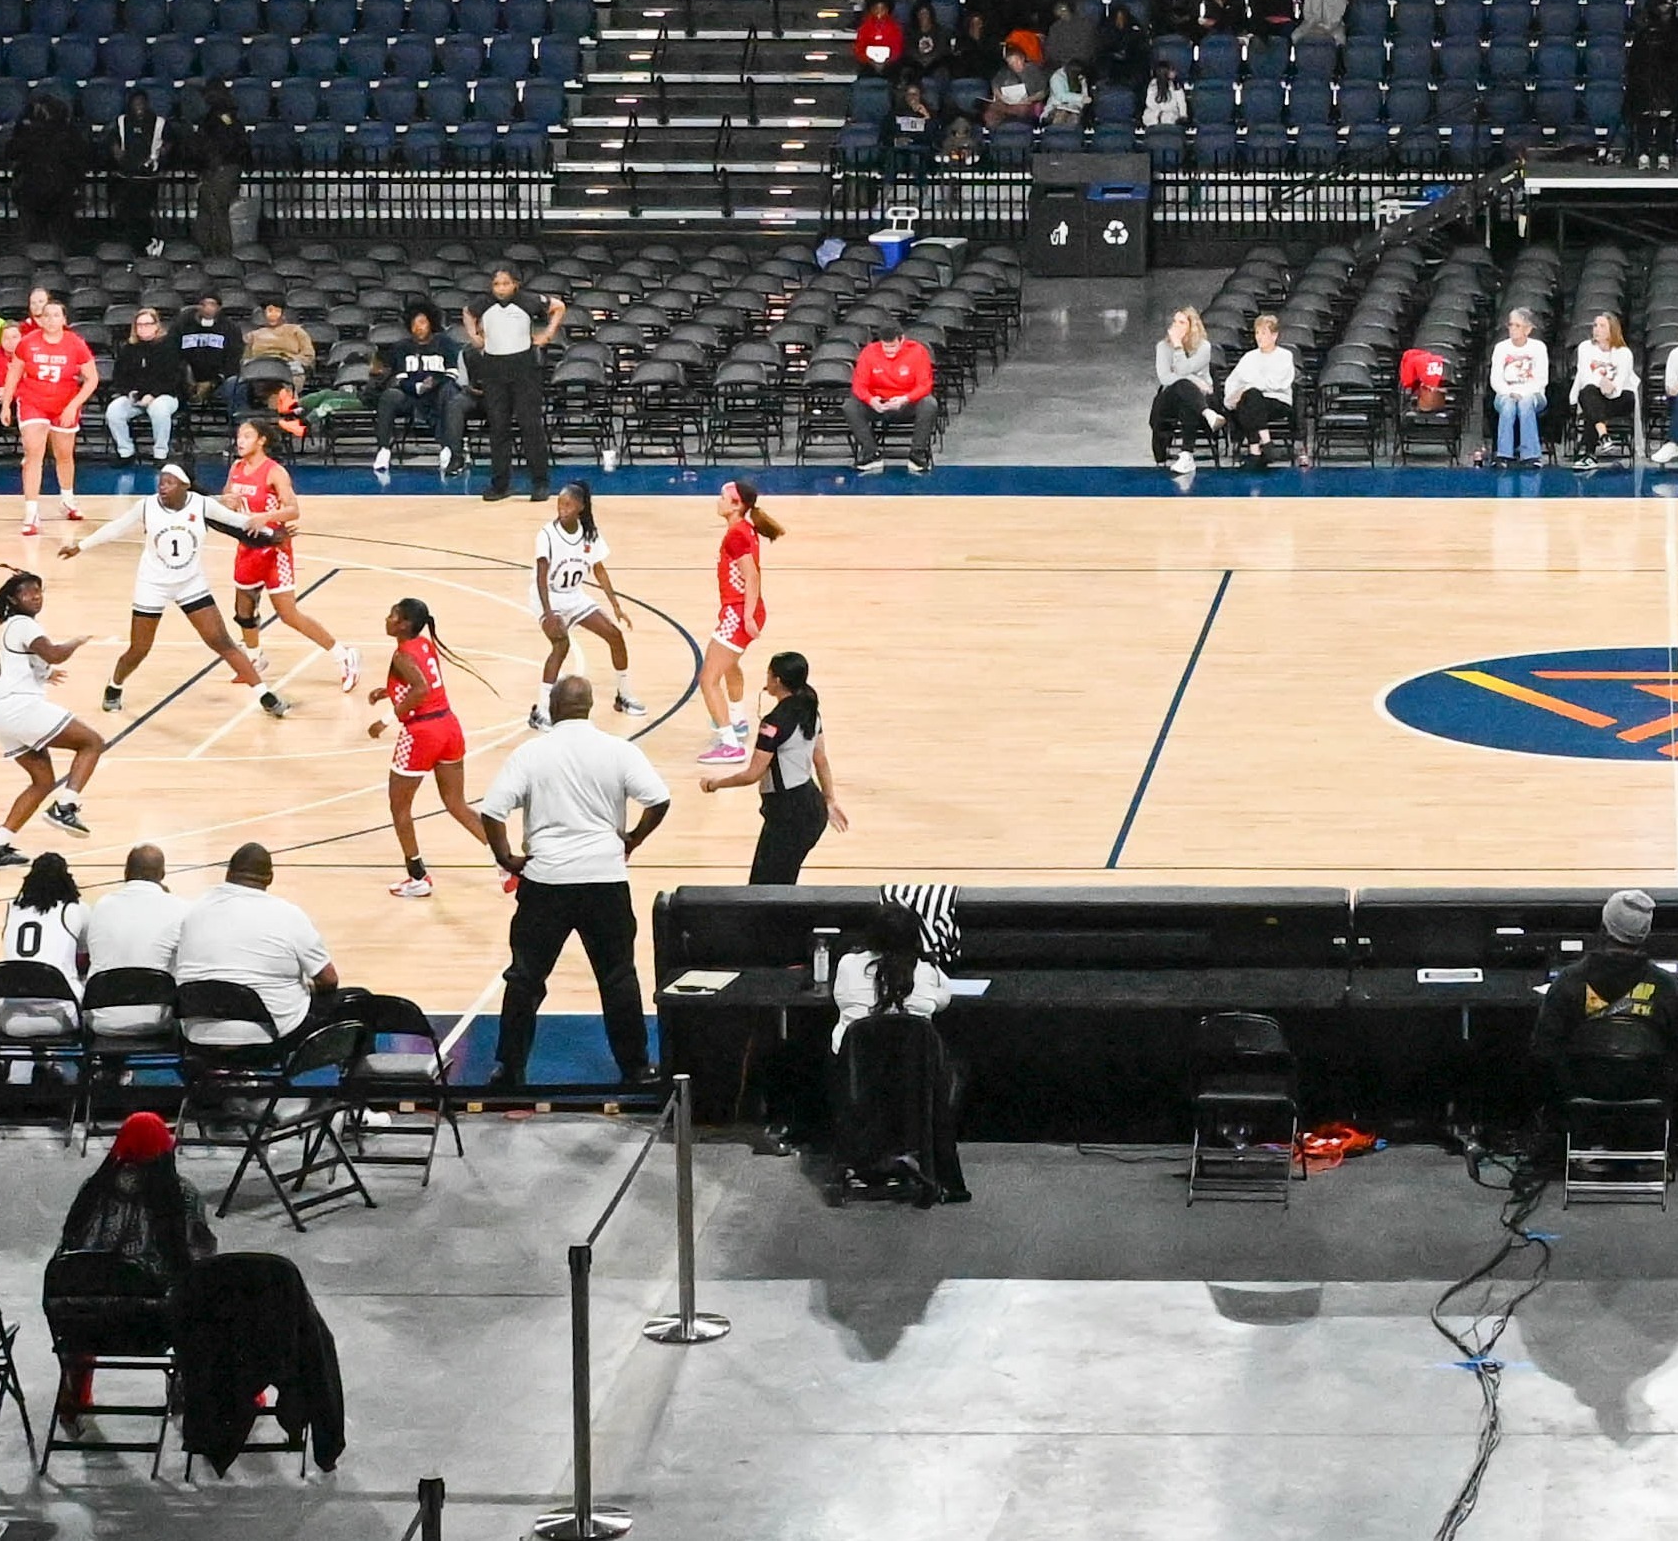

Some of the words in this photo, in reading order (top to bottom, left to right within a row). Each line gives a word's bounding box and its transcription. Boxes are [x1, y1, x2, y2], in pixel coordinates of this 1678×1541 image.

[37, 364, 62, 383] 23
[171, 539, 180, 557] 1
[560, 569, 584, 589] 10
[426, 656, 443, 690] 3
[16, 920, 43, 957] 0
